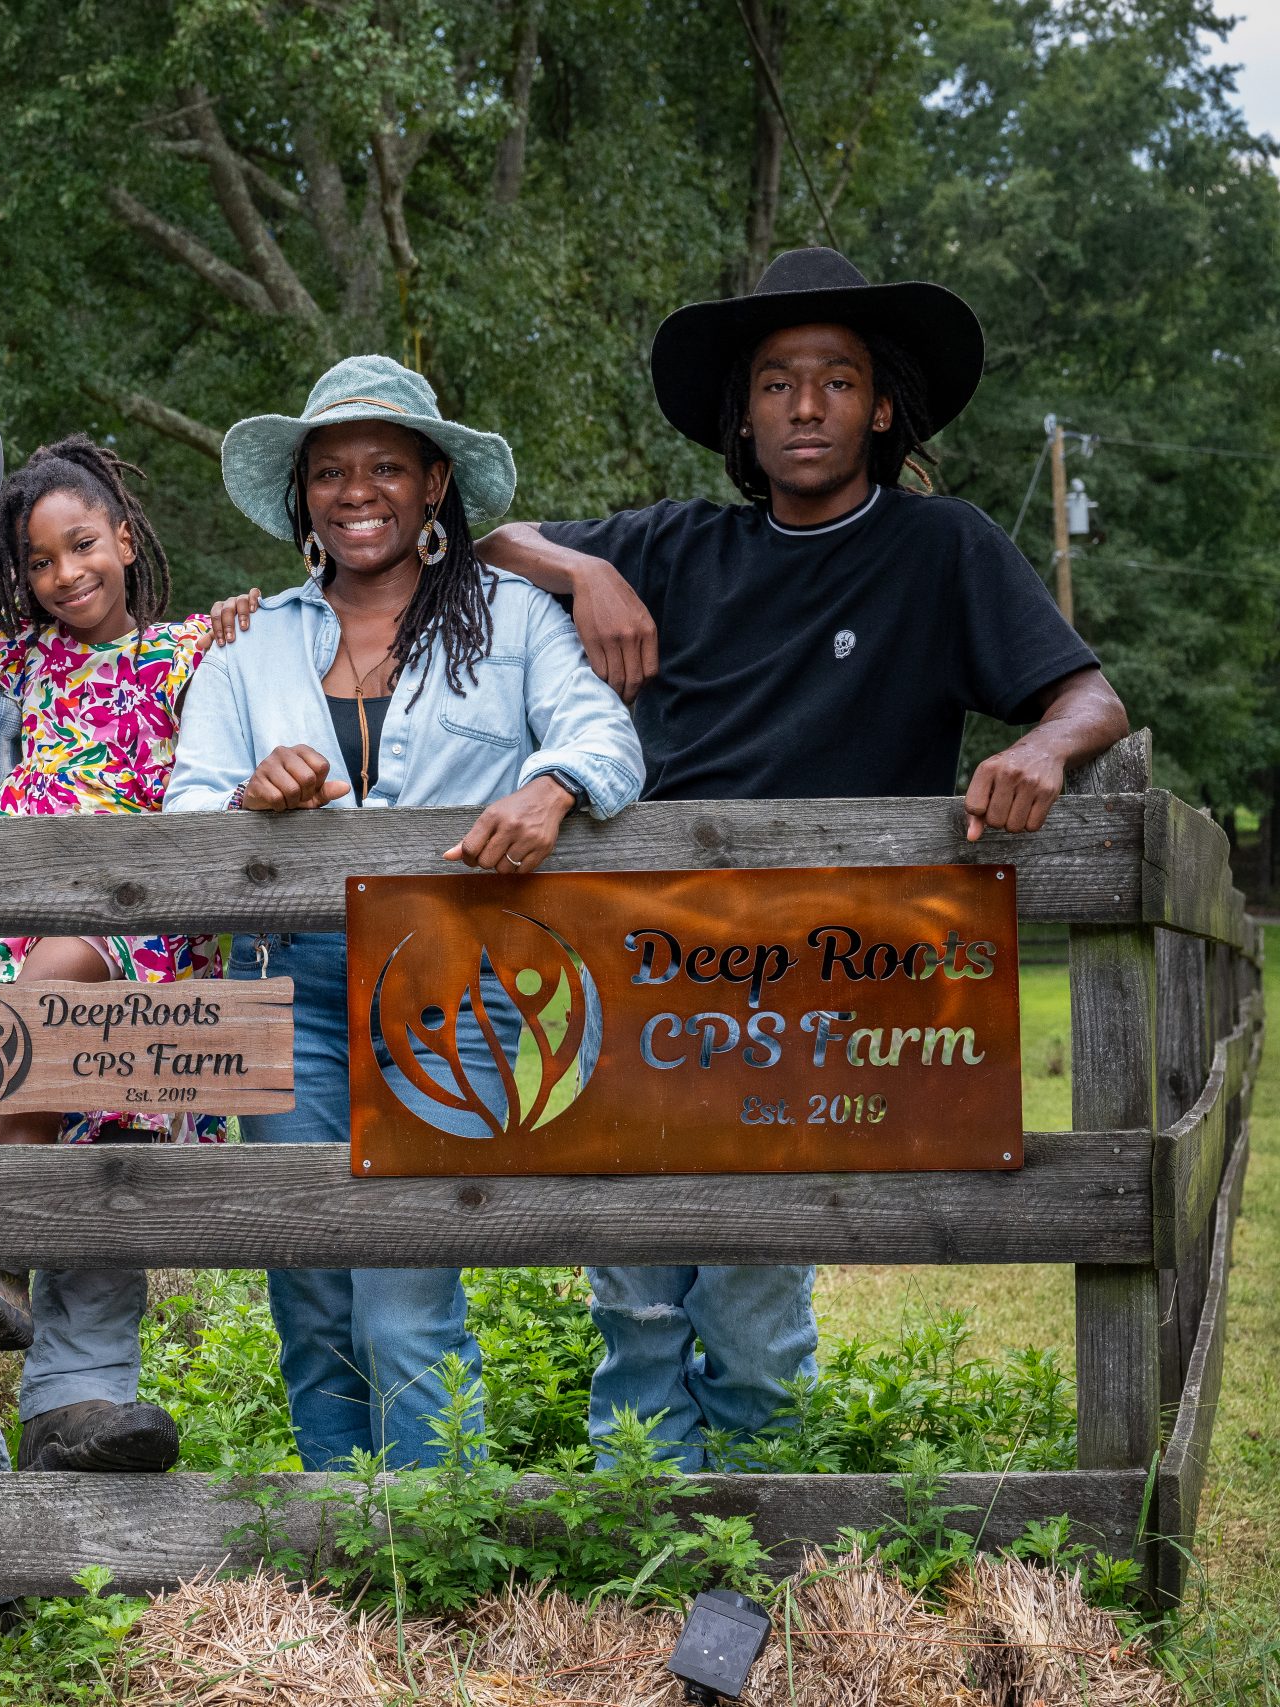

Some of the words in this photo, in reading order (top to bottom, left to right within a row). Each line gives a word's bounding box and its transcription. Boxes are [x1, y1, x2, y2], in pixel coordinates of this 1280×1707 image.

[624, 928, 798, 1008] Deep
[807, 925, 997, 981] Roots
[38, 993, 220, 1042] DeepRoots
[73, 1051, 136, 1077] CPS
[147, 1043, 248, 1076] Farm
[640, 1010, 786, 1069] CPS
[800, 1010, 986, 1068] Farm
[126, 1088, 153, 1102] Est.
[158, 1087, 197, 1102] 2019
[740, 1095, 796, 1125] Est.
[807, 1094, 888, 1124] 2019
